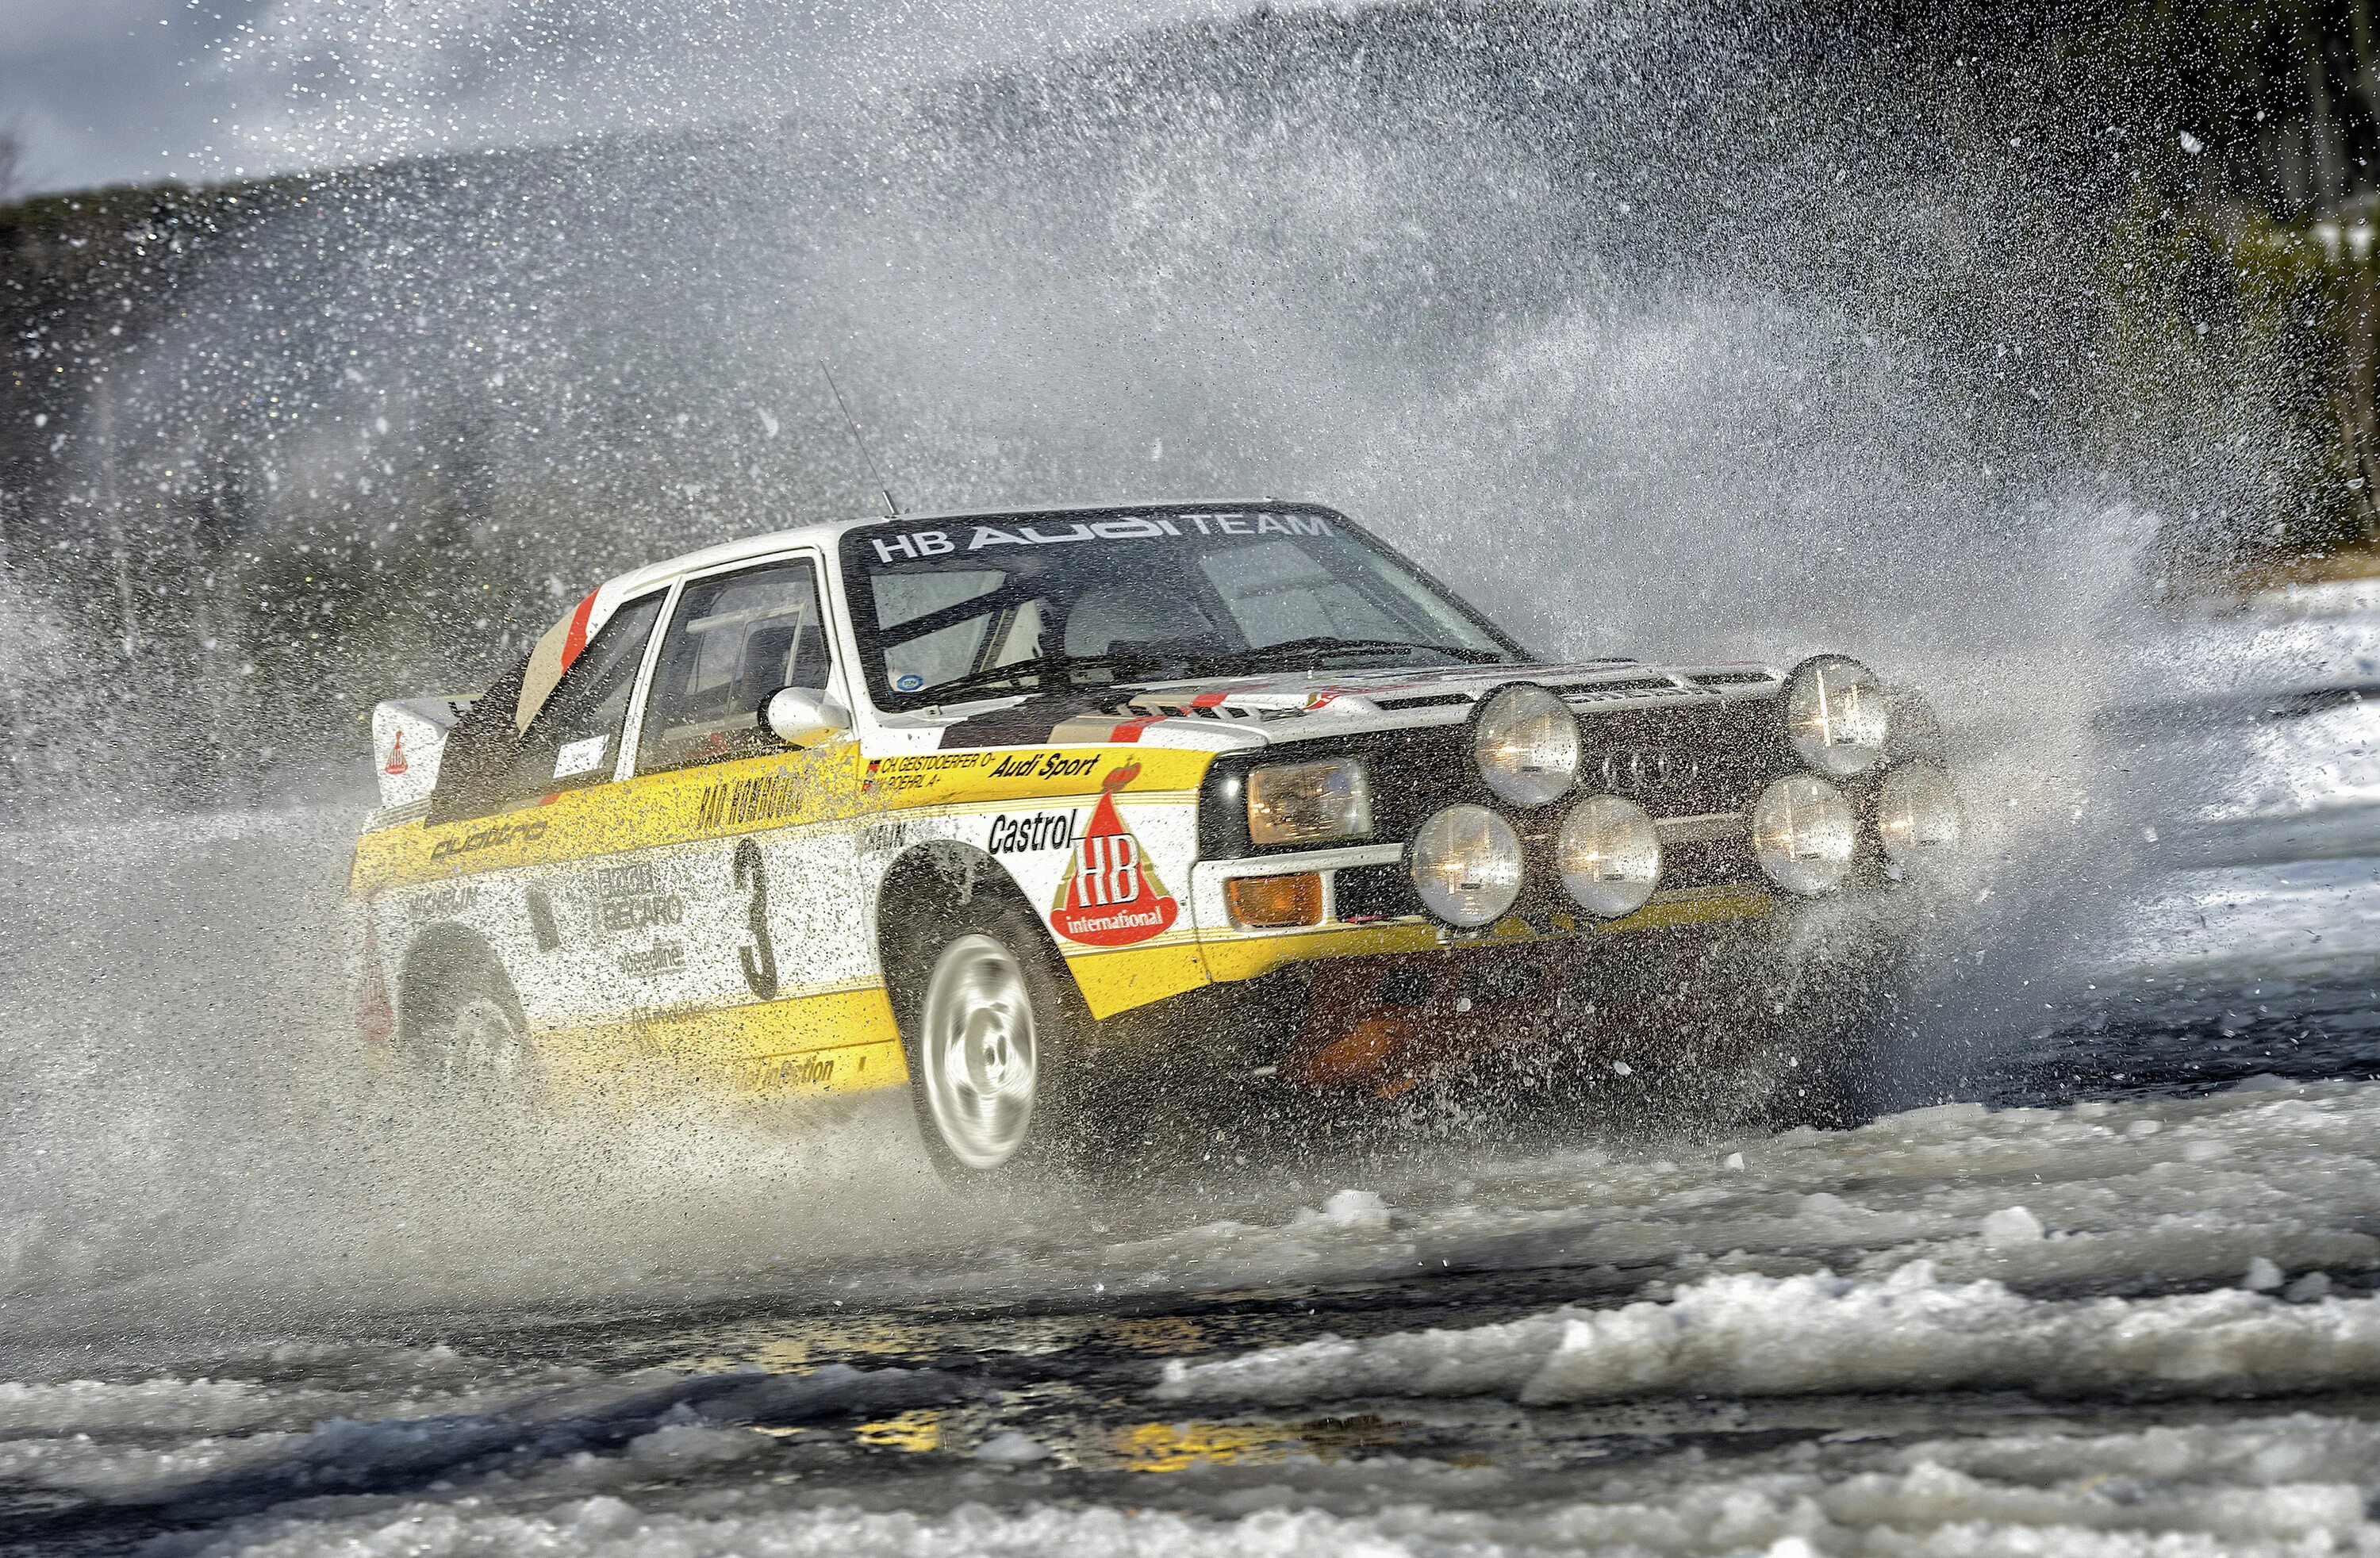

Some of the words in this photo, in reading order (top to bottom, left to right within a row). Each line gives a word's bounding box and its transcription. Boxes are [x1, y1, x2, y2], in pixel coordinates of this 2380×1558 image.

[871, 530, 955, 563] HB
[1180, 512, 1334, 537] TEAM
[898, 753, 977, 771] GEISTDOERFER
[988, 754, 1041, 778] Audi
[1038, 752, 1101, 780] Sport
[431, 821, 548, 861] quattro
[988, 808, 1078, 855] Castrol
[1073, 833, 1141, 908] HB
[733, 836, 778, 1000] 3
[1065, 906, 1164, 934] international
[617, 936, 685, 979] speedline
